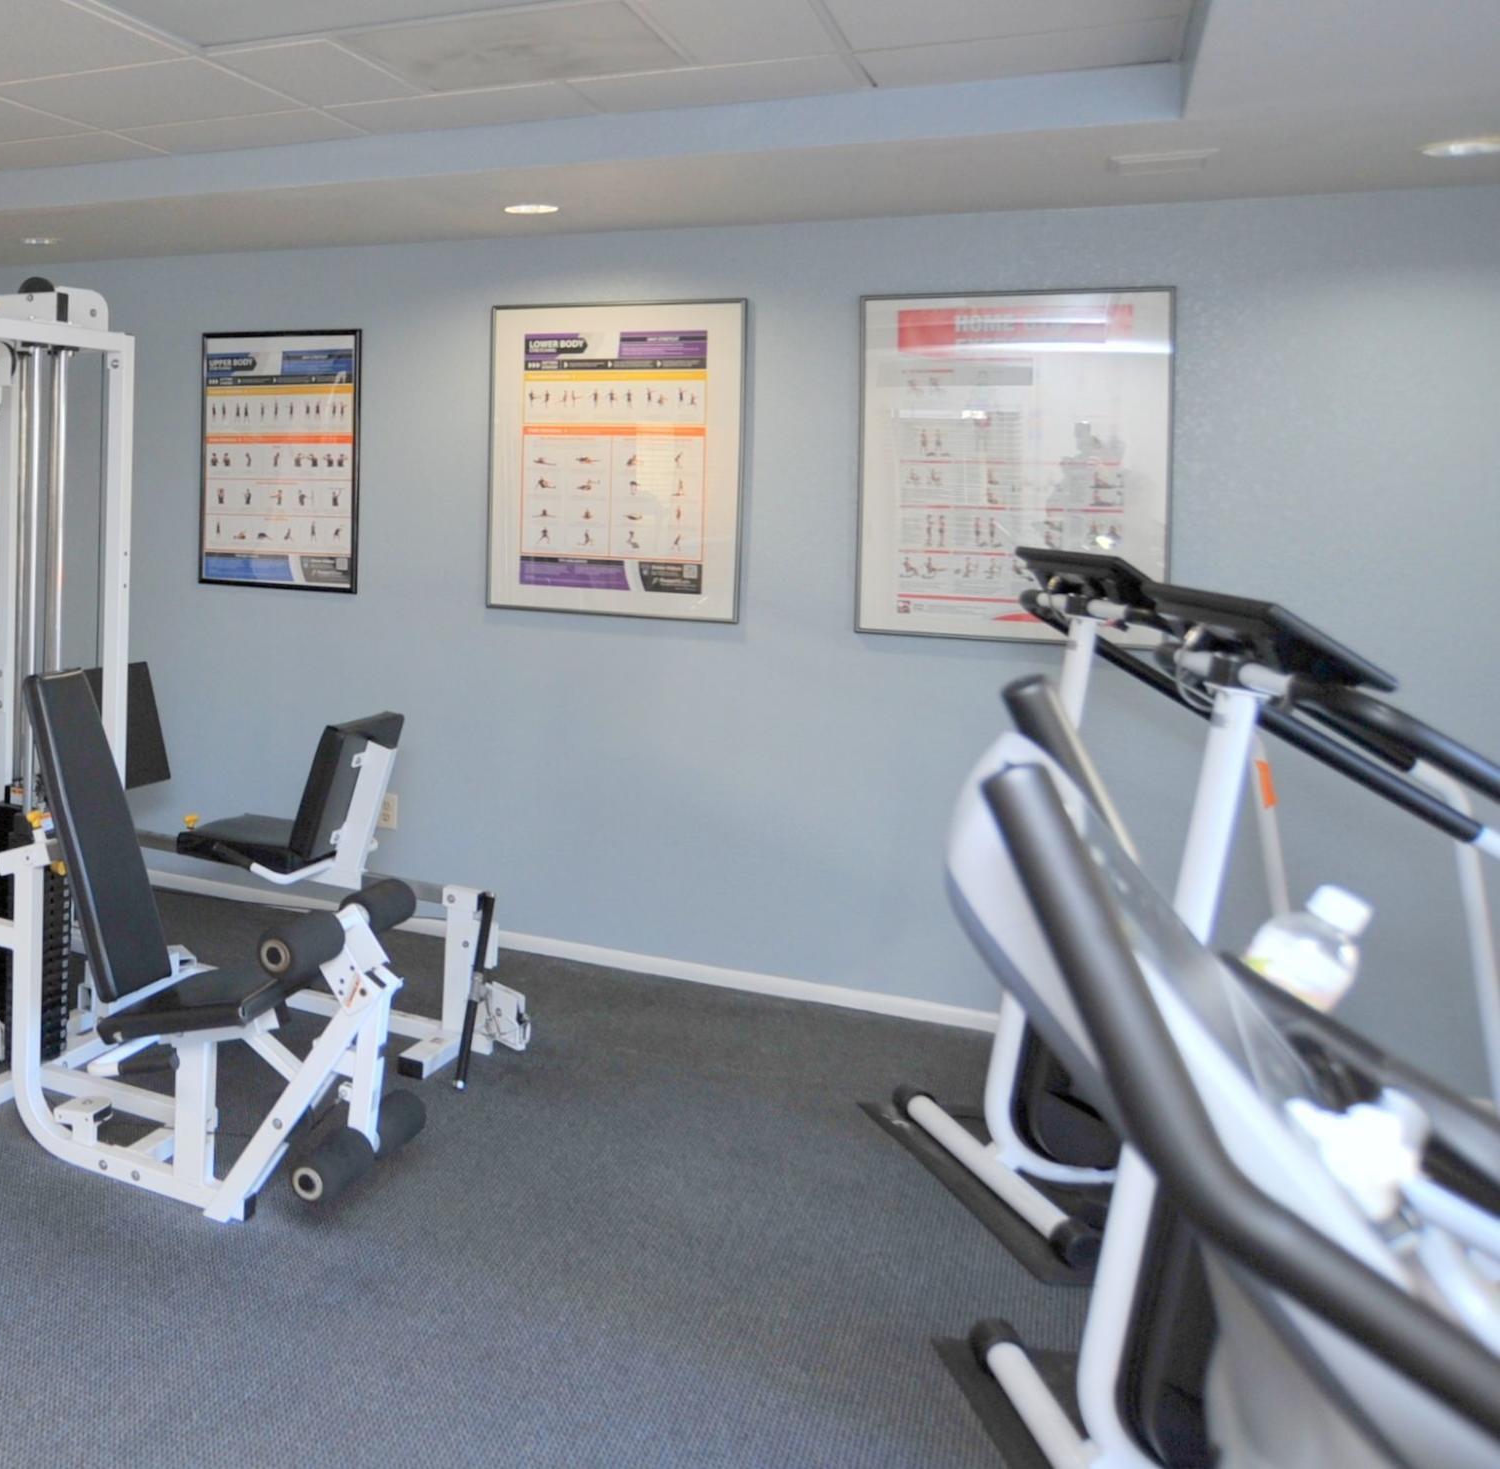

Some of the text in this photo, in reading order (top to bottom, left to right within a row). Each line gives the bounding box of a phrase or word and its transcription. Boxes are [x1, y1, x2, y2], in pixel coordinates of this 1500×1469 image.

[528, 339, 584, 349] LOWER BODY
[209, 357, 253, 368] UPPER BODY
